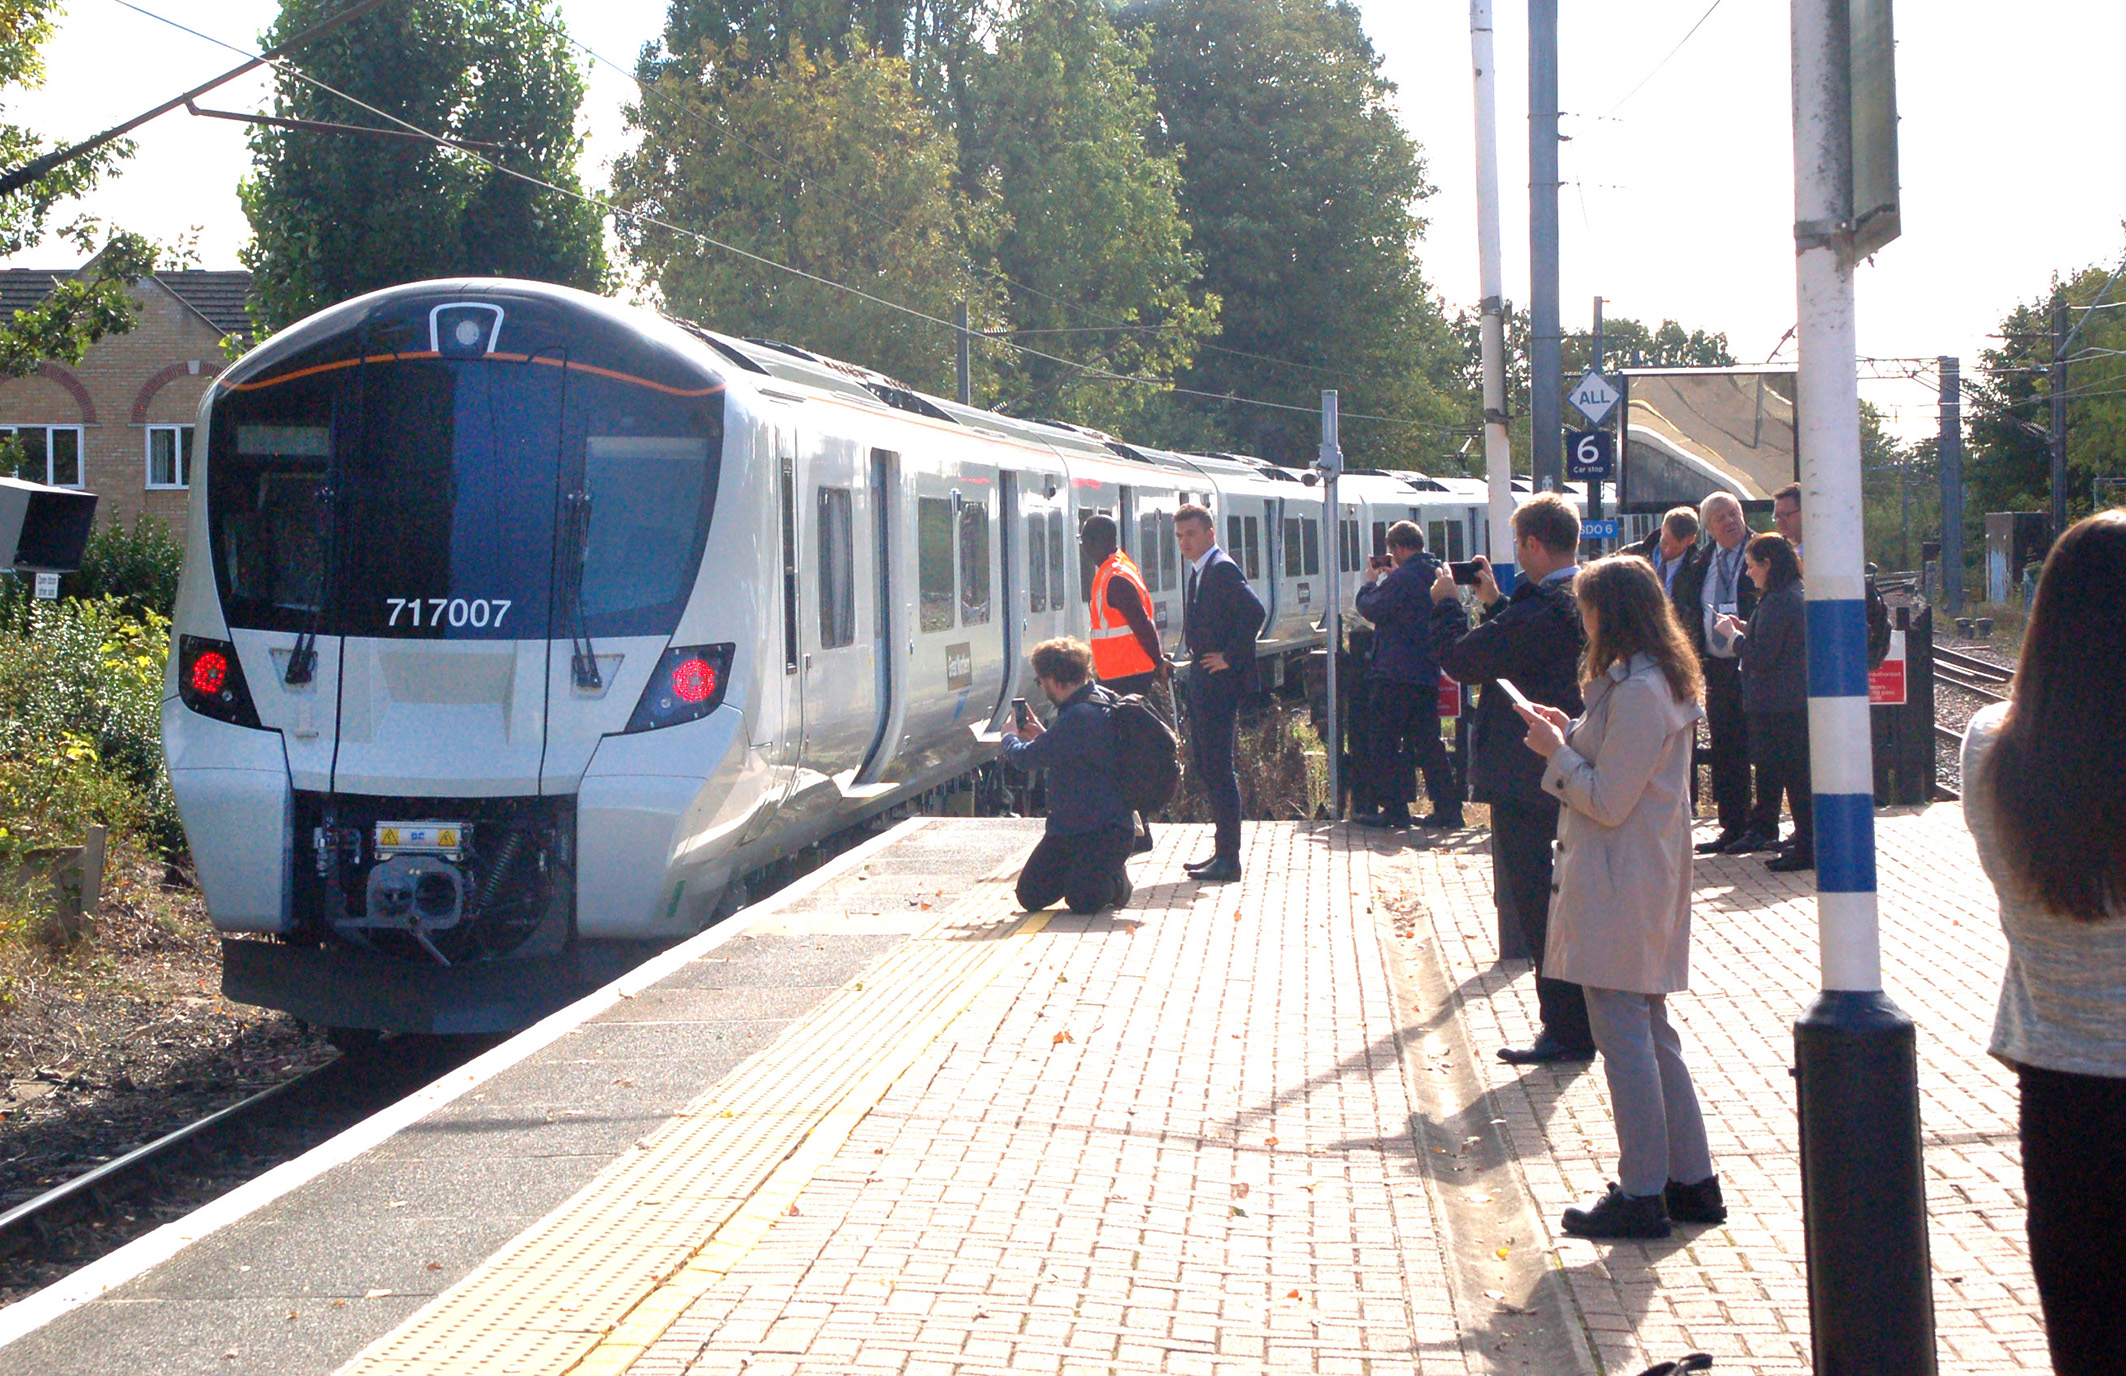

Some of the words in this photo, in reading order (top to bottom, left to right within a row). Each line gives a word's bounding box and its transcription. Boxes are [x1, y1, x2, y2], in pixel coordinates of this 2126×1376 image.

[1579, 390, 1611, 404] ALL
[1577, 435, 1599, 464] 6
[1580, 524, 1602, 535] SDO
[1605, 524, 1613, 535] 6
[386, 598, 512, 628] 717007
